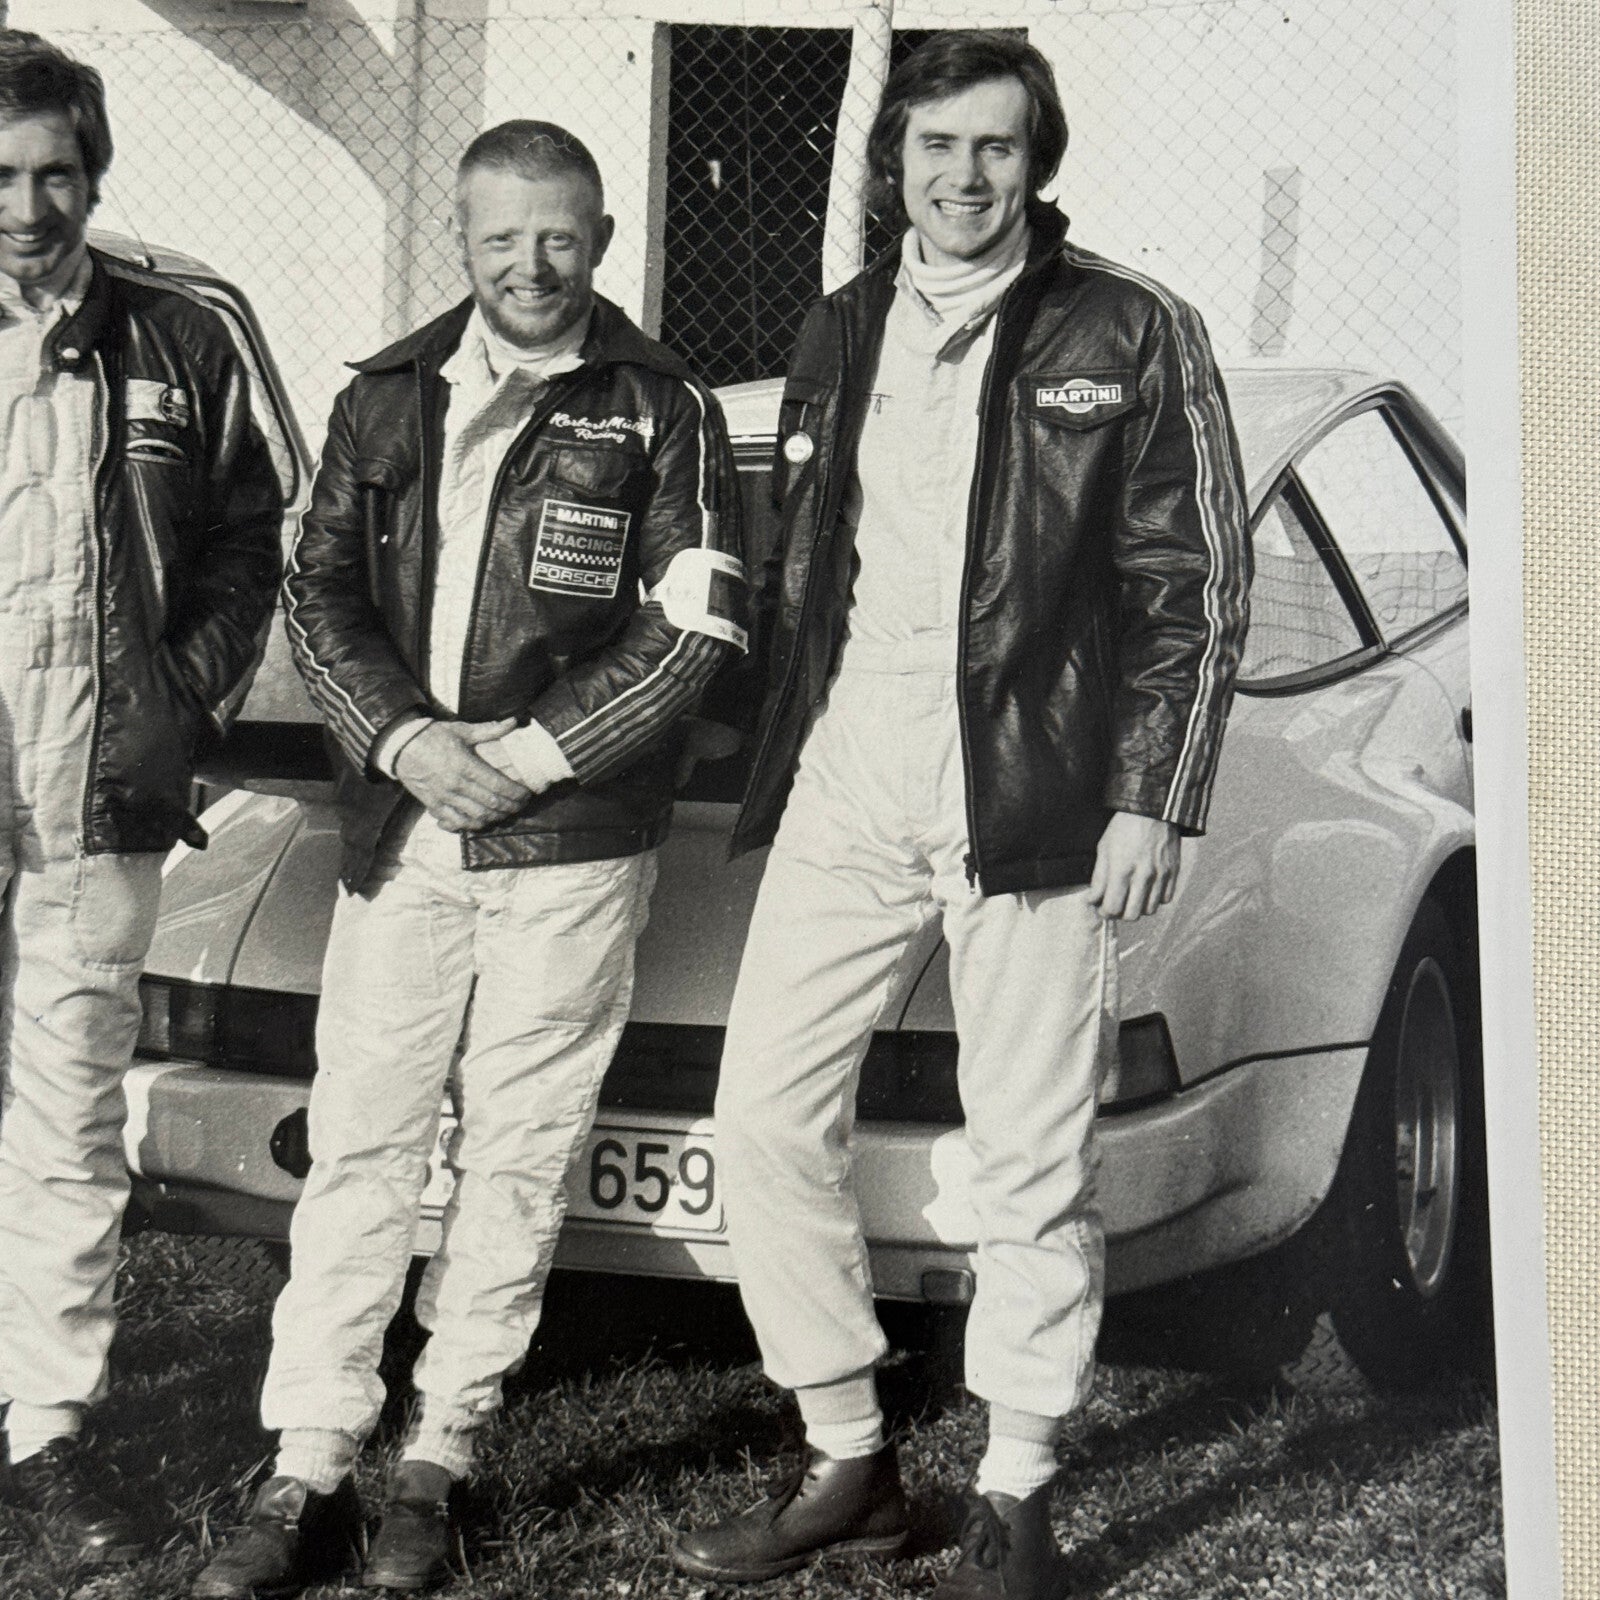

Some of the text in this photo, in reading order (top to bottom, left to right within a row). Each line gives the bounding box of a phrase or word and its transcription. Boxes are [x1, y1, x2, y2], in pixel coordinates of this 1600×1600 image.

[1040, 387, 1118, 404] MARTINI
[574, 428, 626, 444] Racing
[555, 508, 618, 530] MARTINI
[552, 532, 614, 552] RACING
[534, 565, 616, 587] PORSCHE
[590, 1137, 715, 1216] 659
